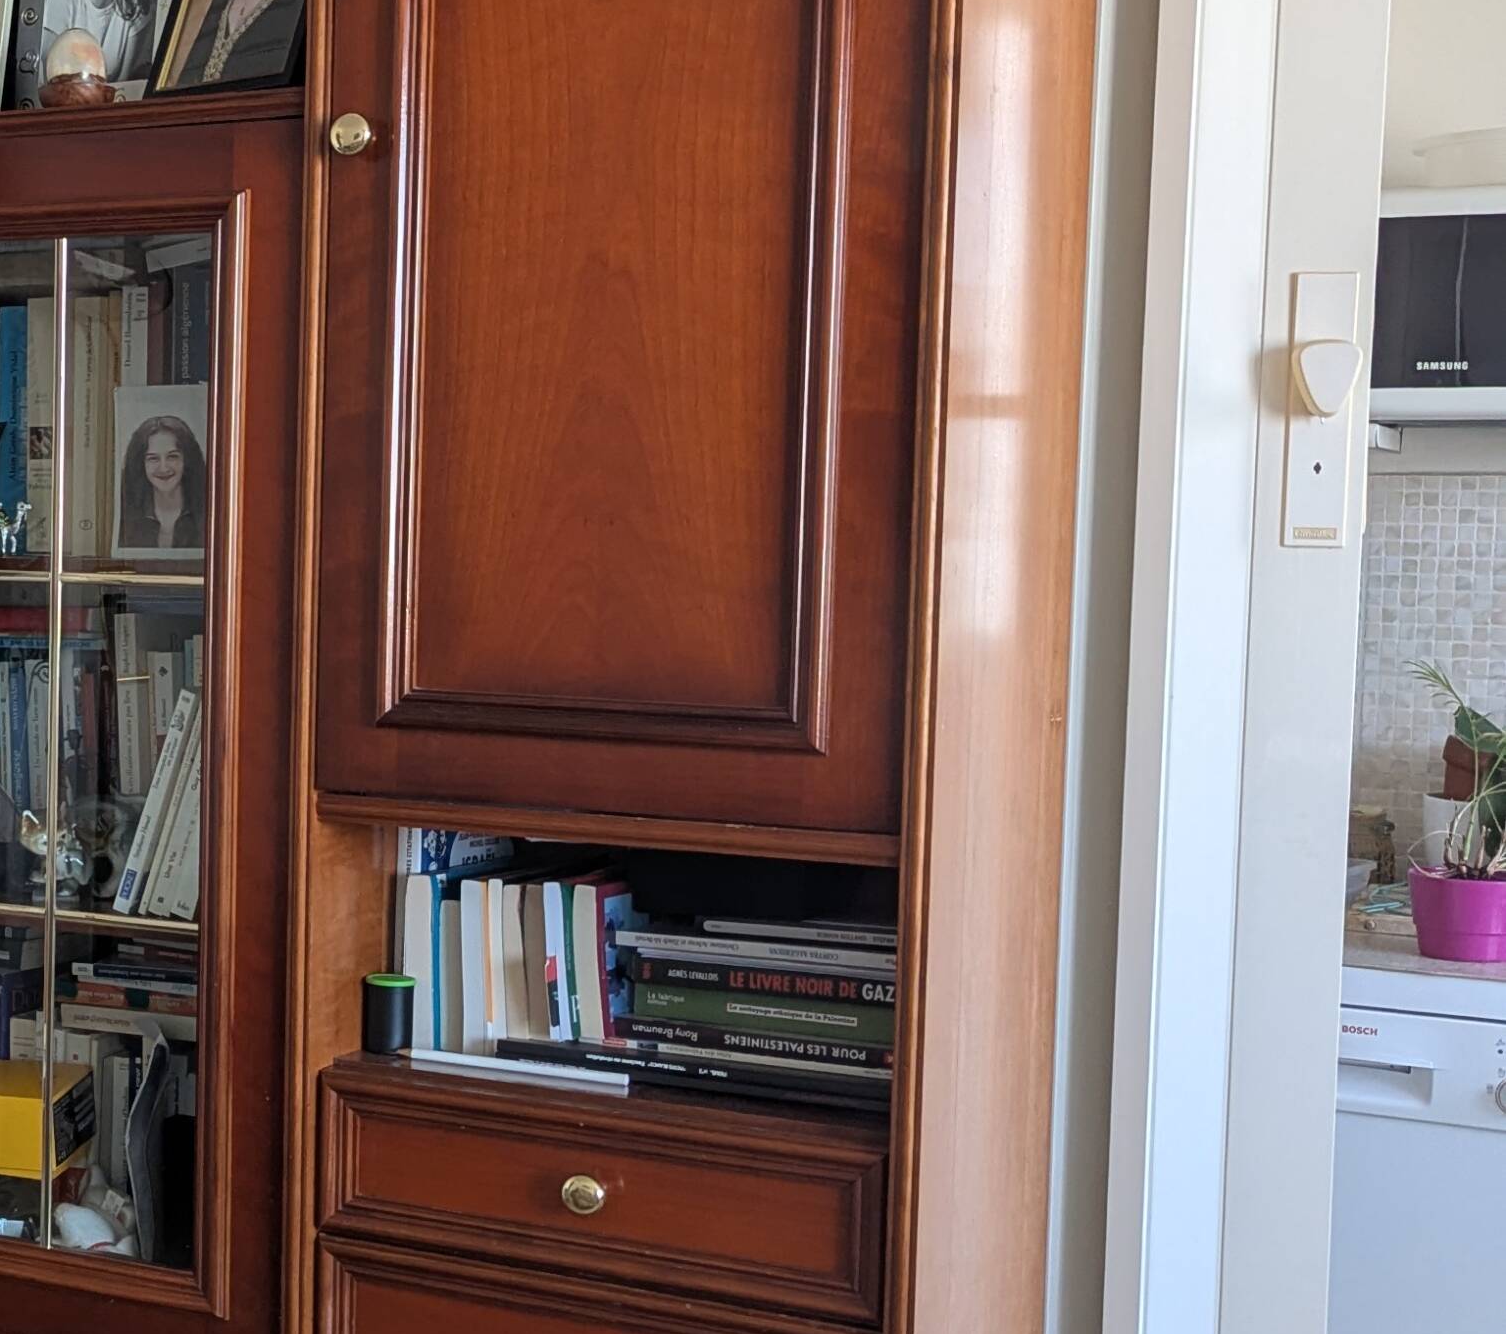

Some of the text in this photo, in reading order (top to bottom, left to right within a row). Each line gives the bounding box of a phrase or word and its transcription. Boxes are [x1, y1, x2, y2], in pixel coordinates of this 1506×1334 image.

[1416, 361, 1469, 371] SAMSUNG
[729, 970, 896, 1003] LE LIVRE NOIR DE GAZ
[647, 991, 685, 1003] La fabrique
[728, 1003, 738, 1011] Le
[738, 1005, 772, 1016] nettoyage
[773, 1009, 804, 1019] ethnique
[822, 1015, 856, 1024] Palestine
[632, 1024, 698, 1042] Rony Brauman
[1342, 1025, 1378, 1036] BOSCH
[723, 1034, 867, 1061] POUR LES PALESTINIENS
